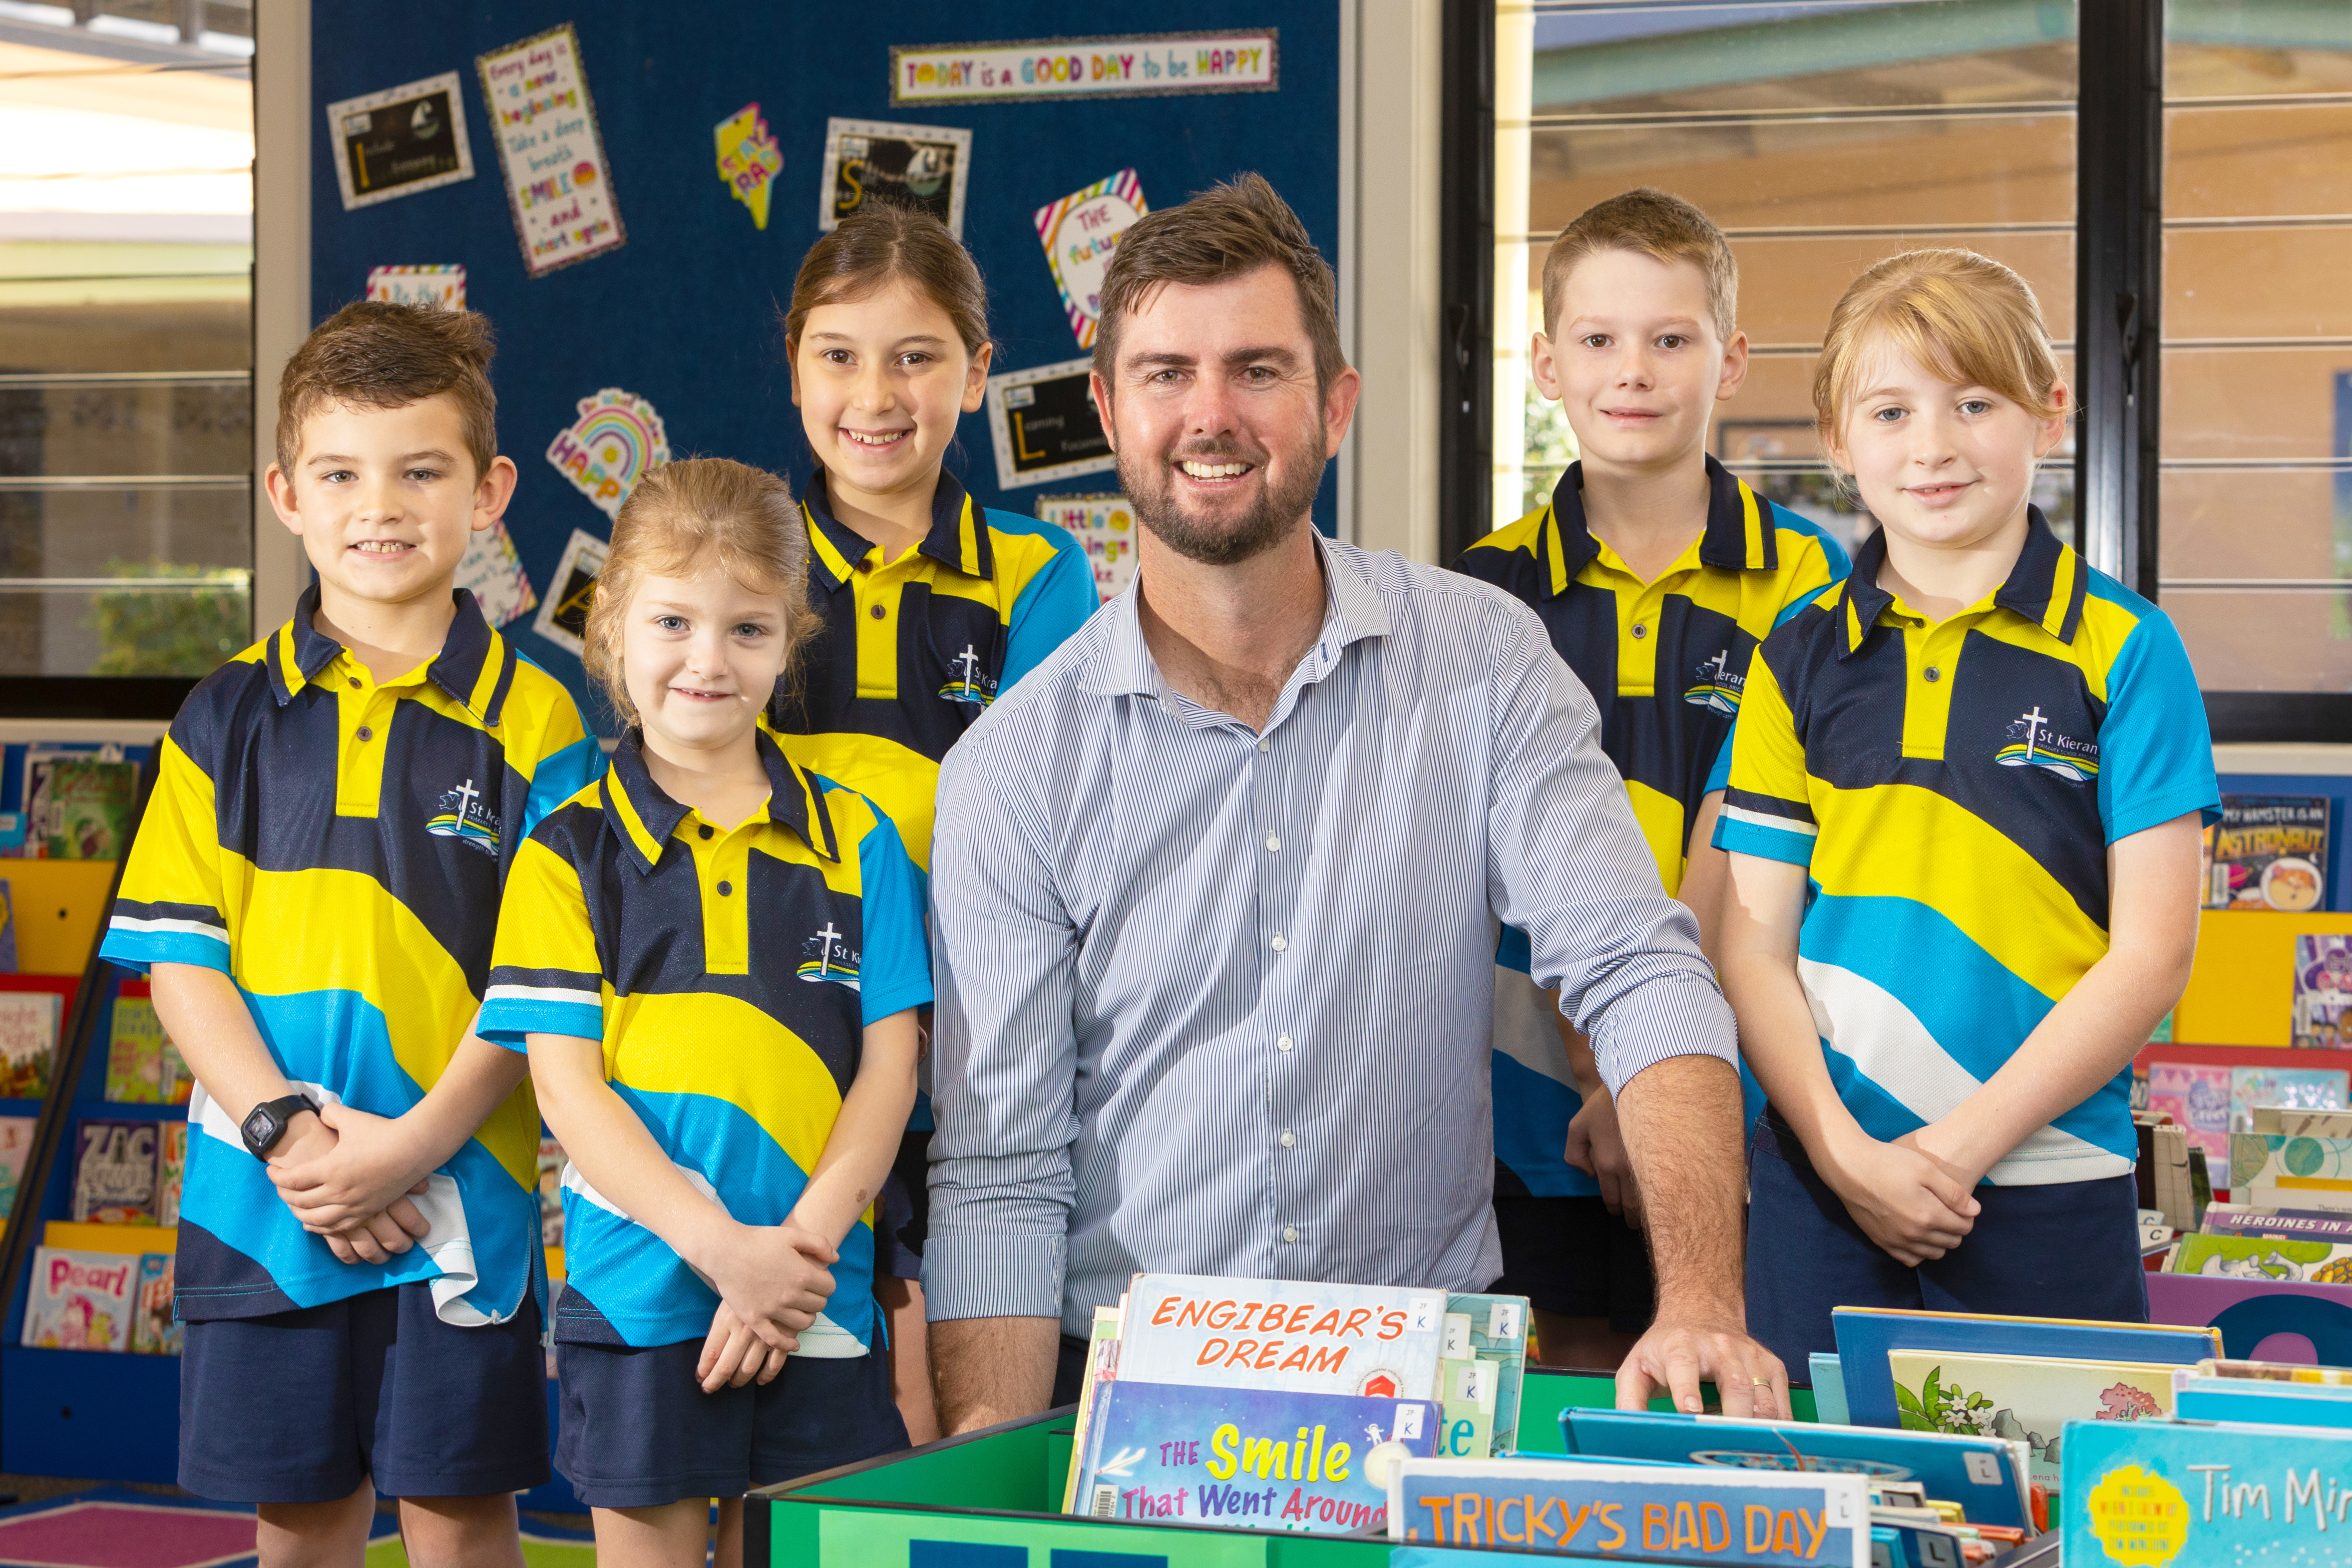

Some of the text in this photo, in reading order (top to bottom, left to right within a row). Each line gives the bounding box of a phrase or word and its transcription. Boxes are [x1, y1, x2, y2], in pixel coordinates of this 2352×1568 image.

[529, 48, 553, 67] day
[907, 61, 974, 88] TODAY
[981, 62, 994, 86] is
[1021, 56, 1083, 83] GOOD
[1092, 54, 1133, 80] DAY
[1143, 52, 1161, 78] to
[1169, 49, 1188, 77] be
[1197, 47, 1262, 75] HAPPY
[520, 172, 572, 210] SMILE
[551, 198, 581, 228] and
[1077, 203, 1111, 232] THE
[1069, 232, 1124, 265] futur
[2039, 729, 2053, 744] St
[469, 802, 483, 816] St
[2215, 826, 2324, 861] ASTRONAUT
[833, 945, 848, 959] St
[83, 1125, 156, 1165] ZAC
[2150, 1229, 2162, 1240] C
[2230, 1214, 2317, 1230] HEROINES
[2321, 1221, 2342, 1232] IN
[51, 1259, 129, 1297] Pearl
[1151, 1296, 1408, 1340] ENGIBEAR'S
[1417, 1316, 1426, 1328] K
[1500, 1322, 1509, 1335] K
[1196, 1338, 1350, 1375] DREAM
[1448, 1339, 1455, 1350] K
[1467, 1385, 1476, 1399] K
[1404, 1423, 1413, 1435] K
[1159, 1423, 1351, 1482] THE Smile
[1981, 1468, 1991, 1479] L
[2186, 1464, 2272, 1523] Tim
[1122, 1484, 1388, 1528] That Went Around
[1840, 1505, 1850, 1518] L
[1419, 1492, 1828, 1560] TRICKY'S BAD DAY
[1928, 1542, 1946, 1562] L
